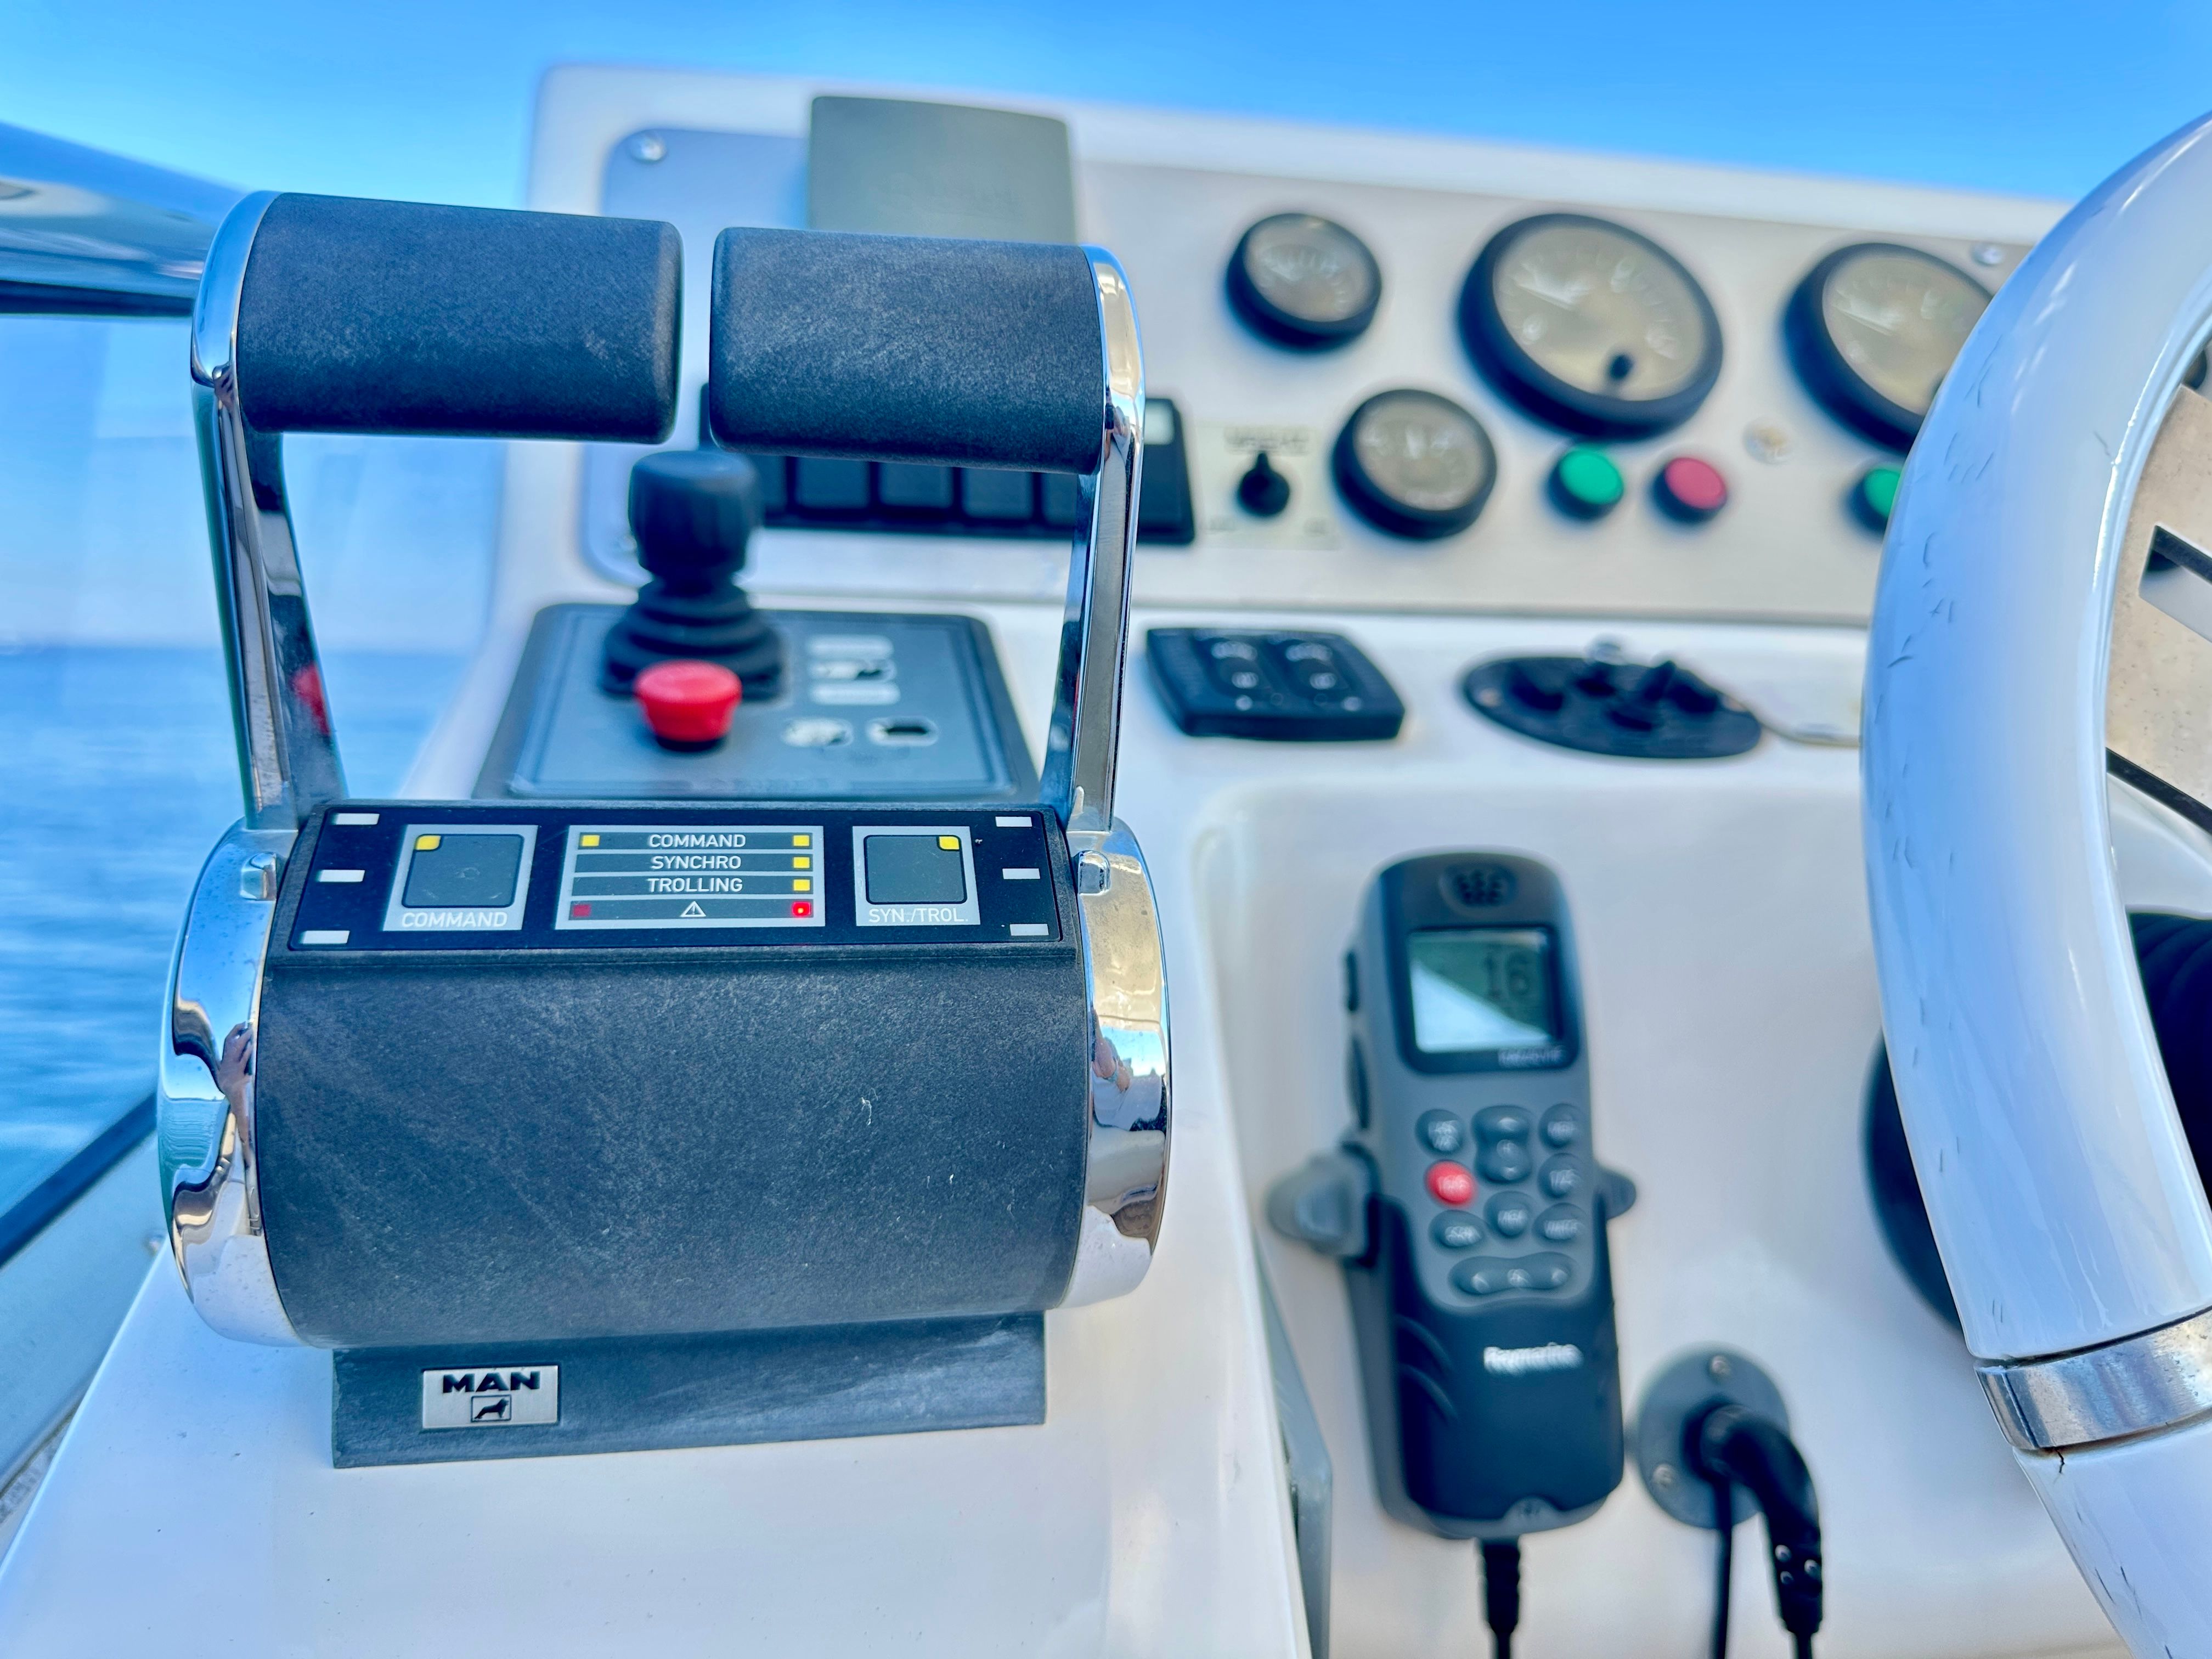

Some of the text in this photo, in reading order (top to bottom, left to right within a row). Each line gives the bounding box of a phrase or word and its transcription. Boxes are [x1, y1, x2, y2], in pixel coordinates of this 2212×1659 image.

[648, 834, 746, 848] COMMAND
[651, 855, 742, 869] SYNCHRO
[647, 878, 743, 892] TROLLING
[401, 911, 508, 928] COMMAND
[868, 907, 969, 923] SYN./TROL.
[442, 1371, 541, 1393] MAN
